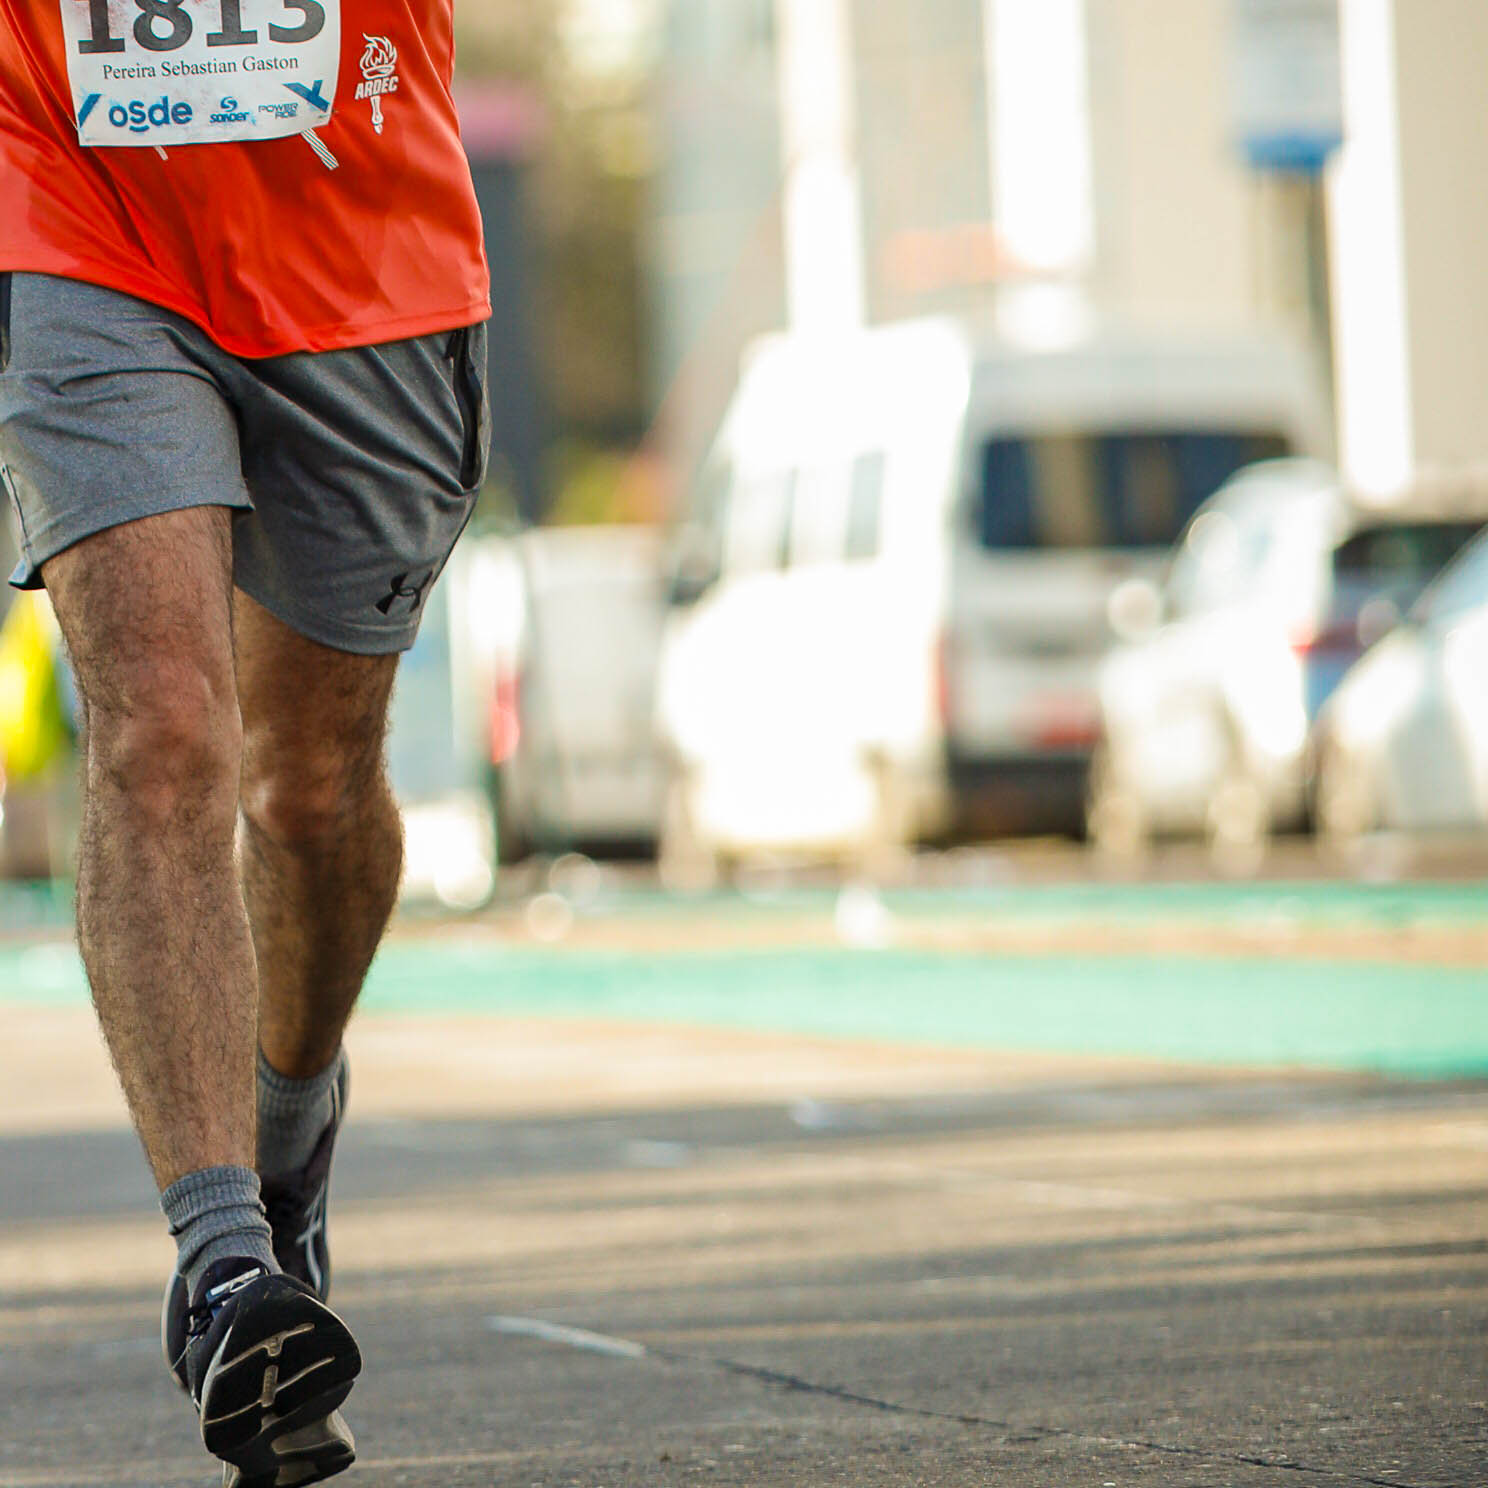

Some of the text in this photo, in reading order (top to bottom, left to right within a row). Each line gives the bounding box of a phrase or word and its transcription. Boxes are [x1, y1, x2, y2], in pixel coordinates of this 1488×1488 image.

[103, 55, 299, 80] Pereira Sebastian Gaston
[355, 76, 399, 101] ARDEC
[109, 95, 193, 128] osde
[258, 102, 299, 113] POWER
